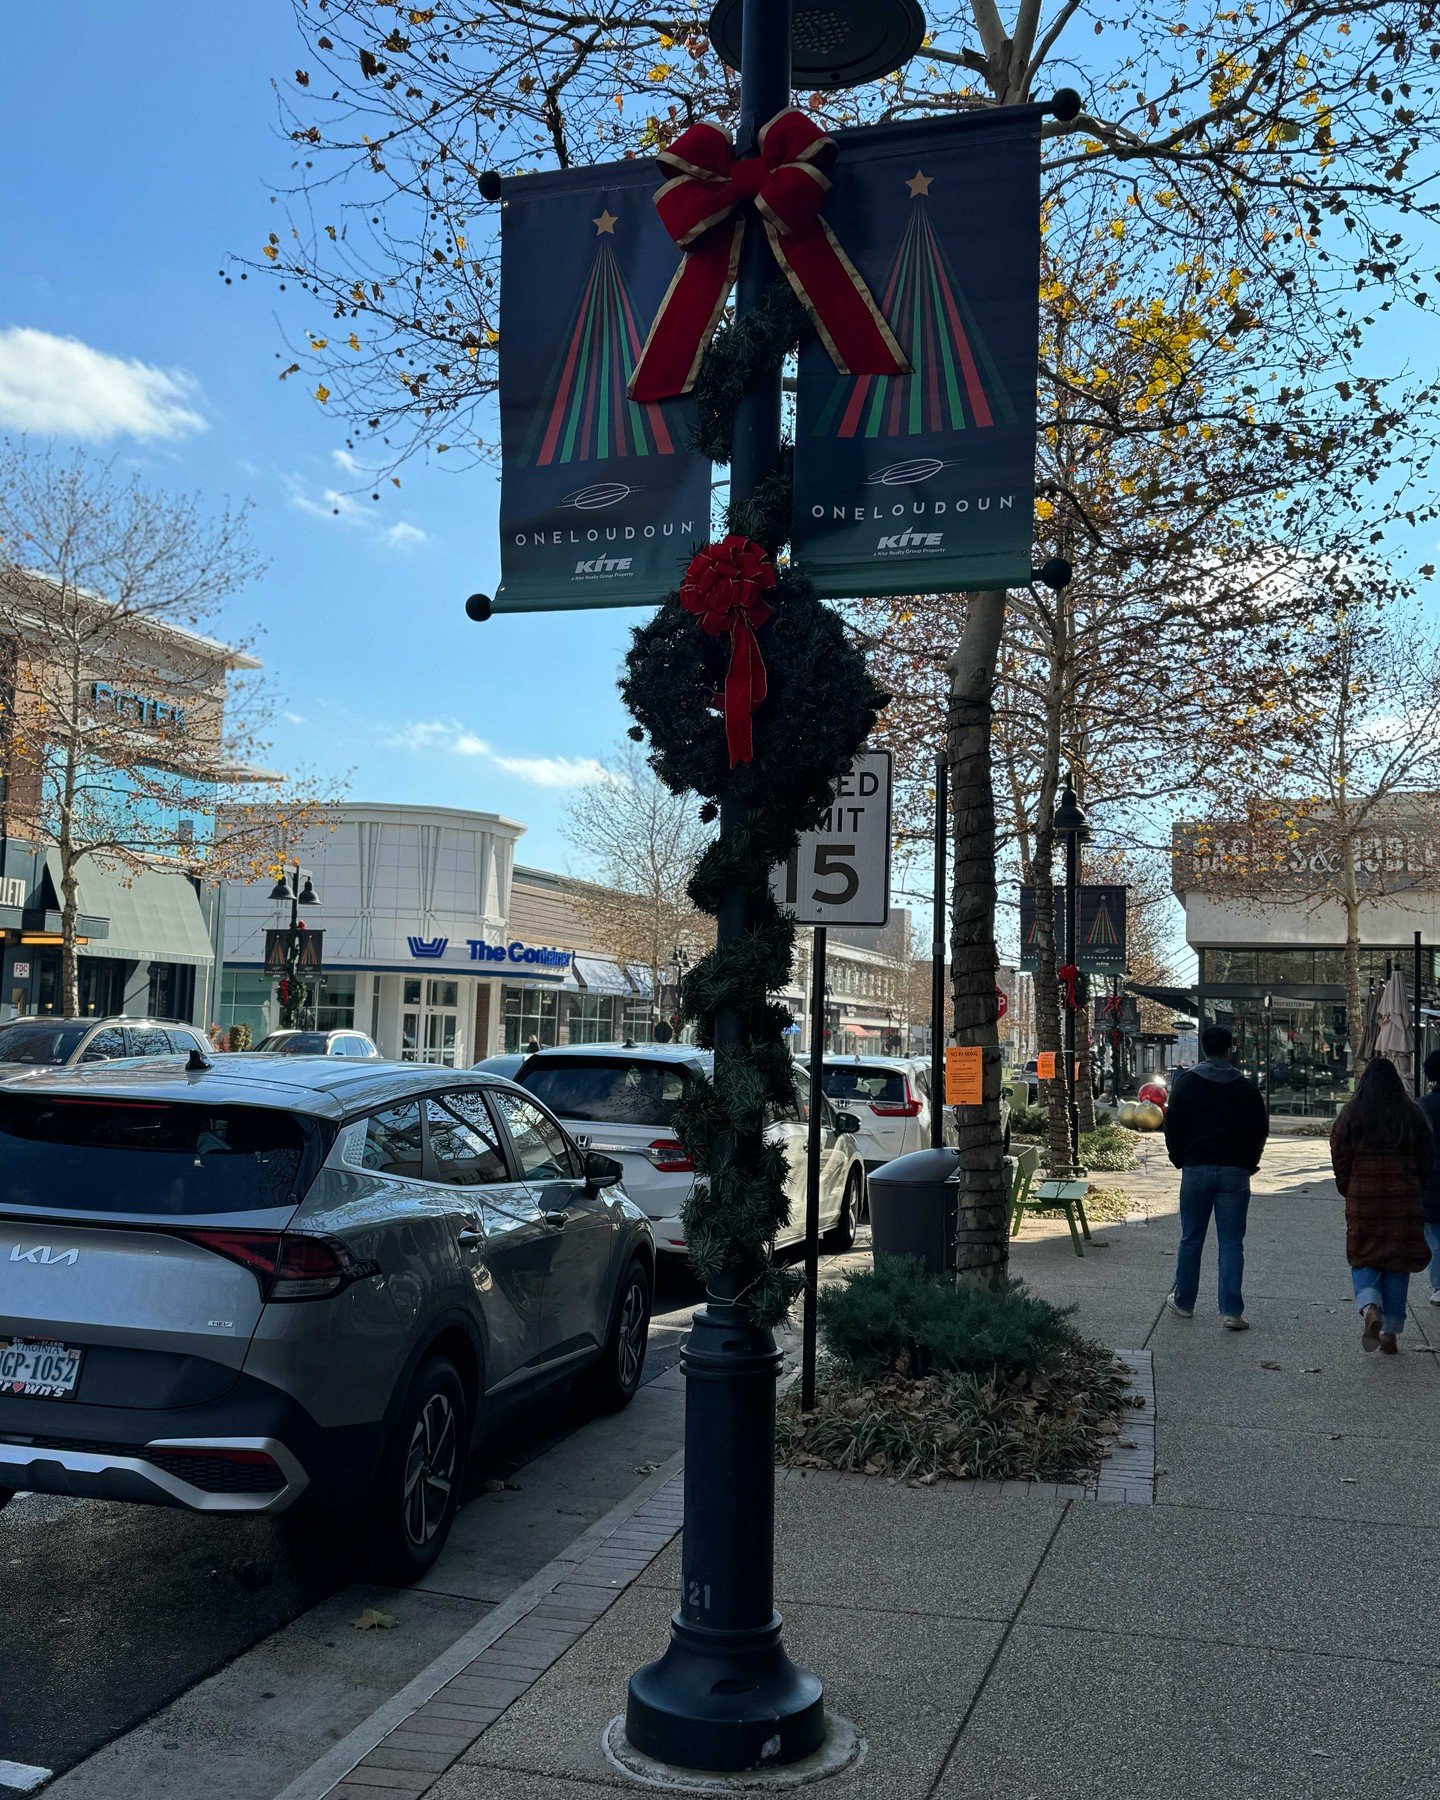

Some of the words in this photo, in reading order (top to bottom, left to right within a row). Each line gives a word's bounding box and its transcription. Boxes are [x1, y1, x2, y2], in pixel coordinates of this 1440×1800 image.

[812, 495, 1013, 520] ONELOUDOUN
[515, 521, 692, 546] ONELOUDOUN
[877, 526, 944, 549] KITE
[574, 552, 633, 574] KITE
[814, 807, 865, 832] MIT
[786, 844, 859, 905] 15
[466, 940, 506, 961] The
[15, 964, 28, 972] FDC
[10, 1244, 79, 1266] KIA
[16, 1342, 60, 1355] VIRGINIA
[682, 1577, 711, 1609] 21
